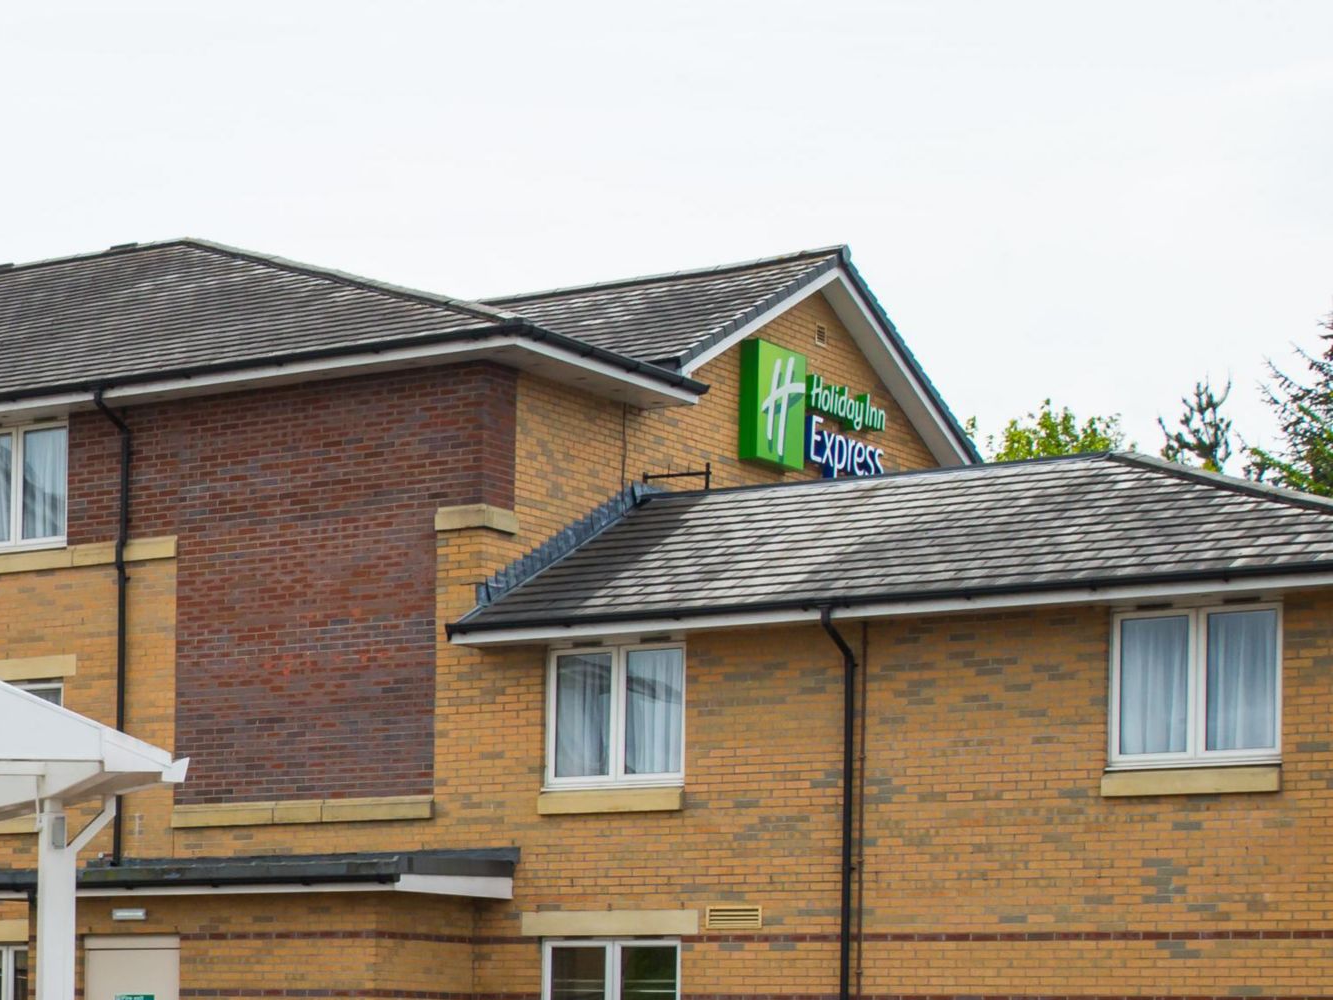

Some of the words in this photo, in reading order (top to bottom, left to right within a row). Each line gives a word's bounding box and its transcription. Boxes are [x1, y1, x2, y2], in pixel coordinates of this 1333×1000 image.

[811, 374, 864, 430] Holiday
[865, 393, 885, 431] Inn
[810, 415, 884, 478] Express
